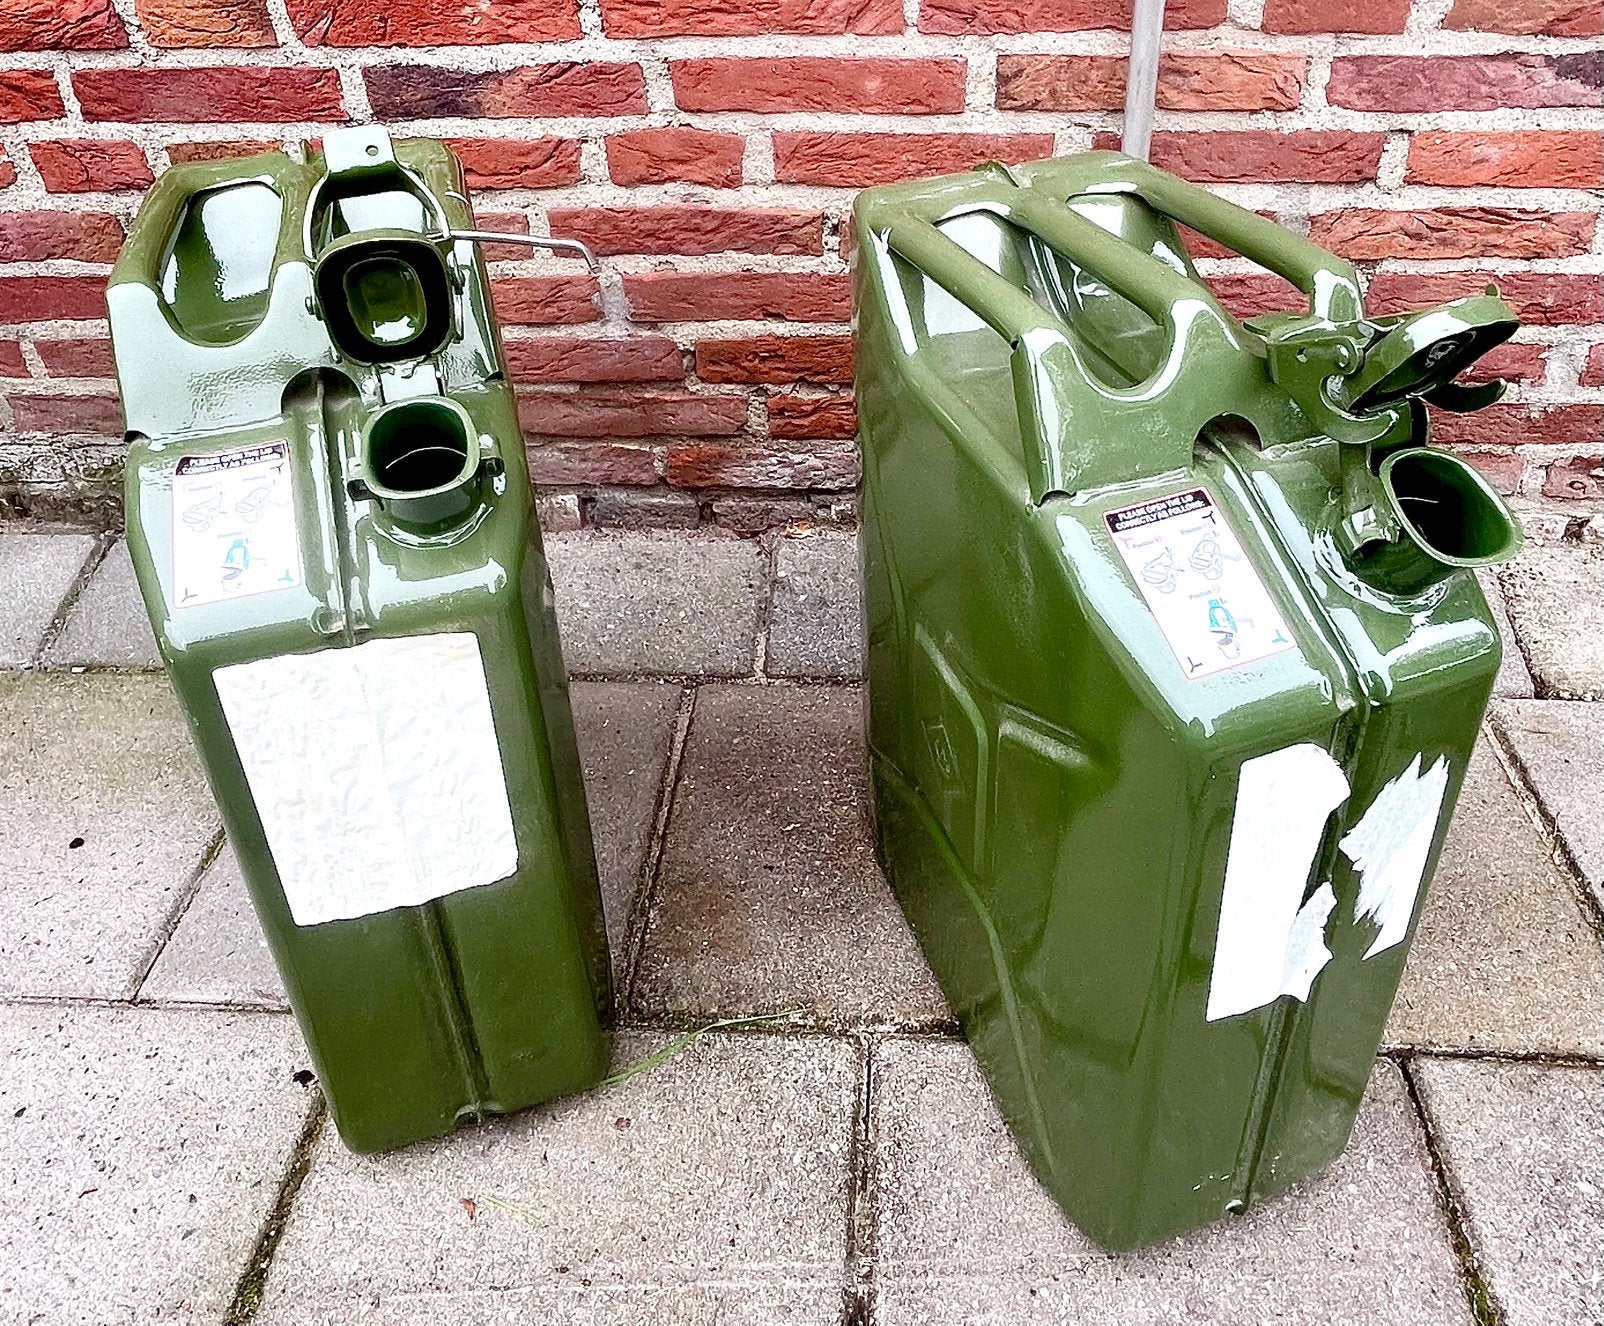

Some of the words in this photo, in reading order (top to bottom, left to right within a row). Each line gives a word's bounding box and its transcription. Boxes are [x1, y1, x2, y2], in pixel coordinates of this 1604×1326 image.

[1115, 513, 1157, 530] CORRECTLY
[1157, 509, 1169, 519] AS
[1118, 508, 1146, 521] PLEASE
[1146, 502, 1167, 512] OPEN
[1166, 497, 1182, 507] THE
[1182, 494, 1194, 503] LID
